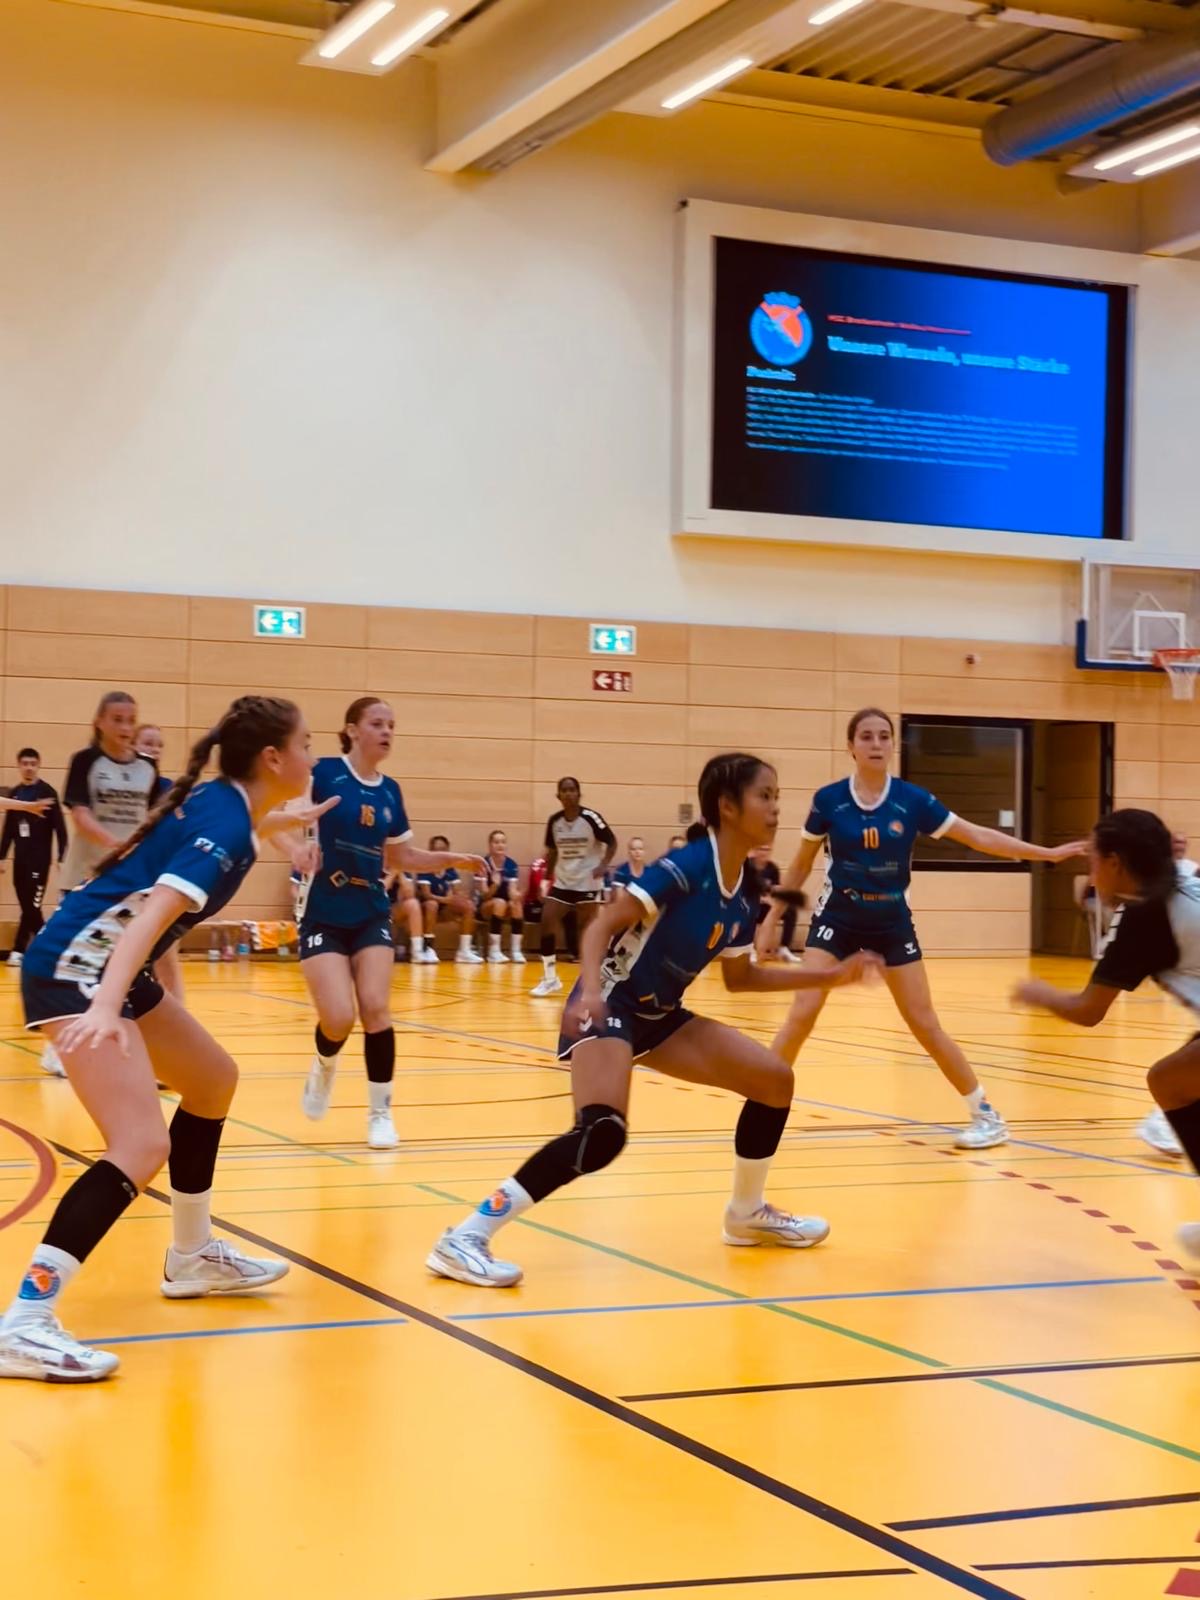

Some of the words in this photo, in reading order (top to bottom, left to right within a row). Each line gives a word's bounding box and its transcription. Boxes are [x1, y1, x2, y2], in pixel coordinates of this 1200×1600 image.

[862, 827, 880, 849] 10
[307, 933, 323, 948] 16
[816, 925, 834, 941] 10
